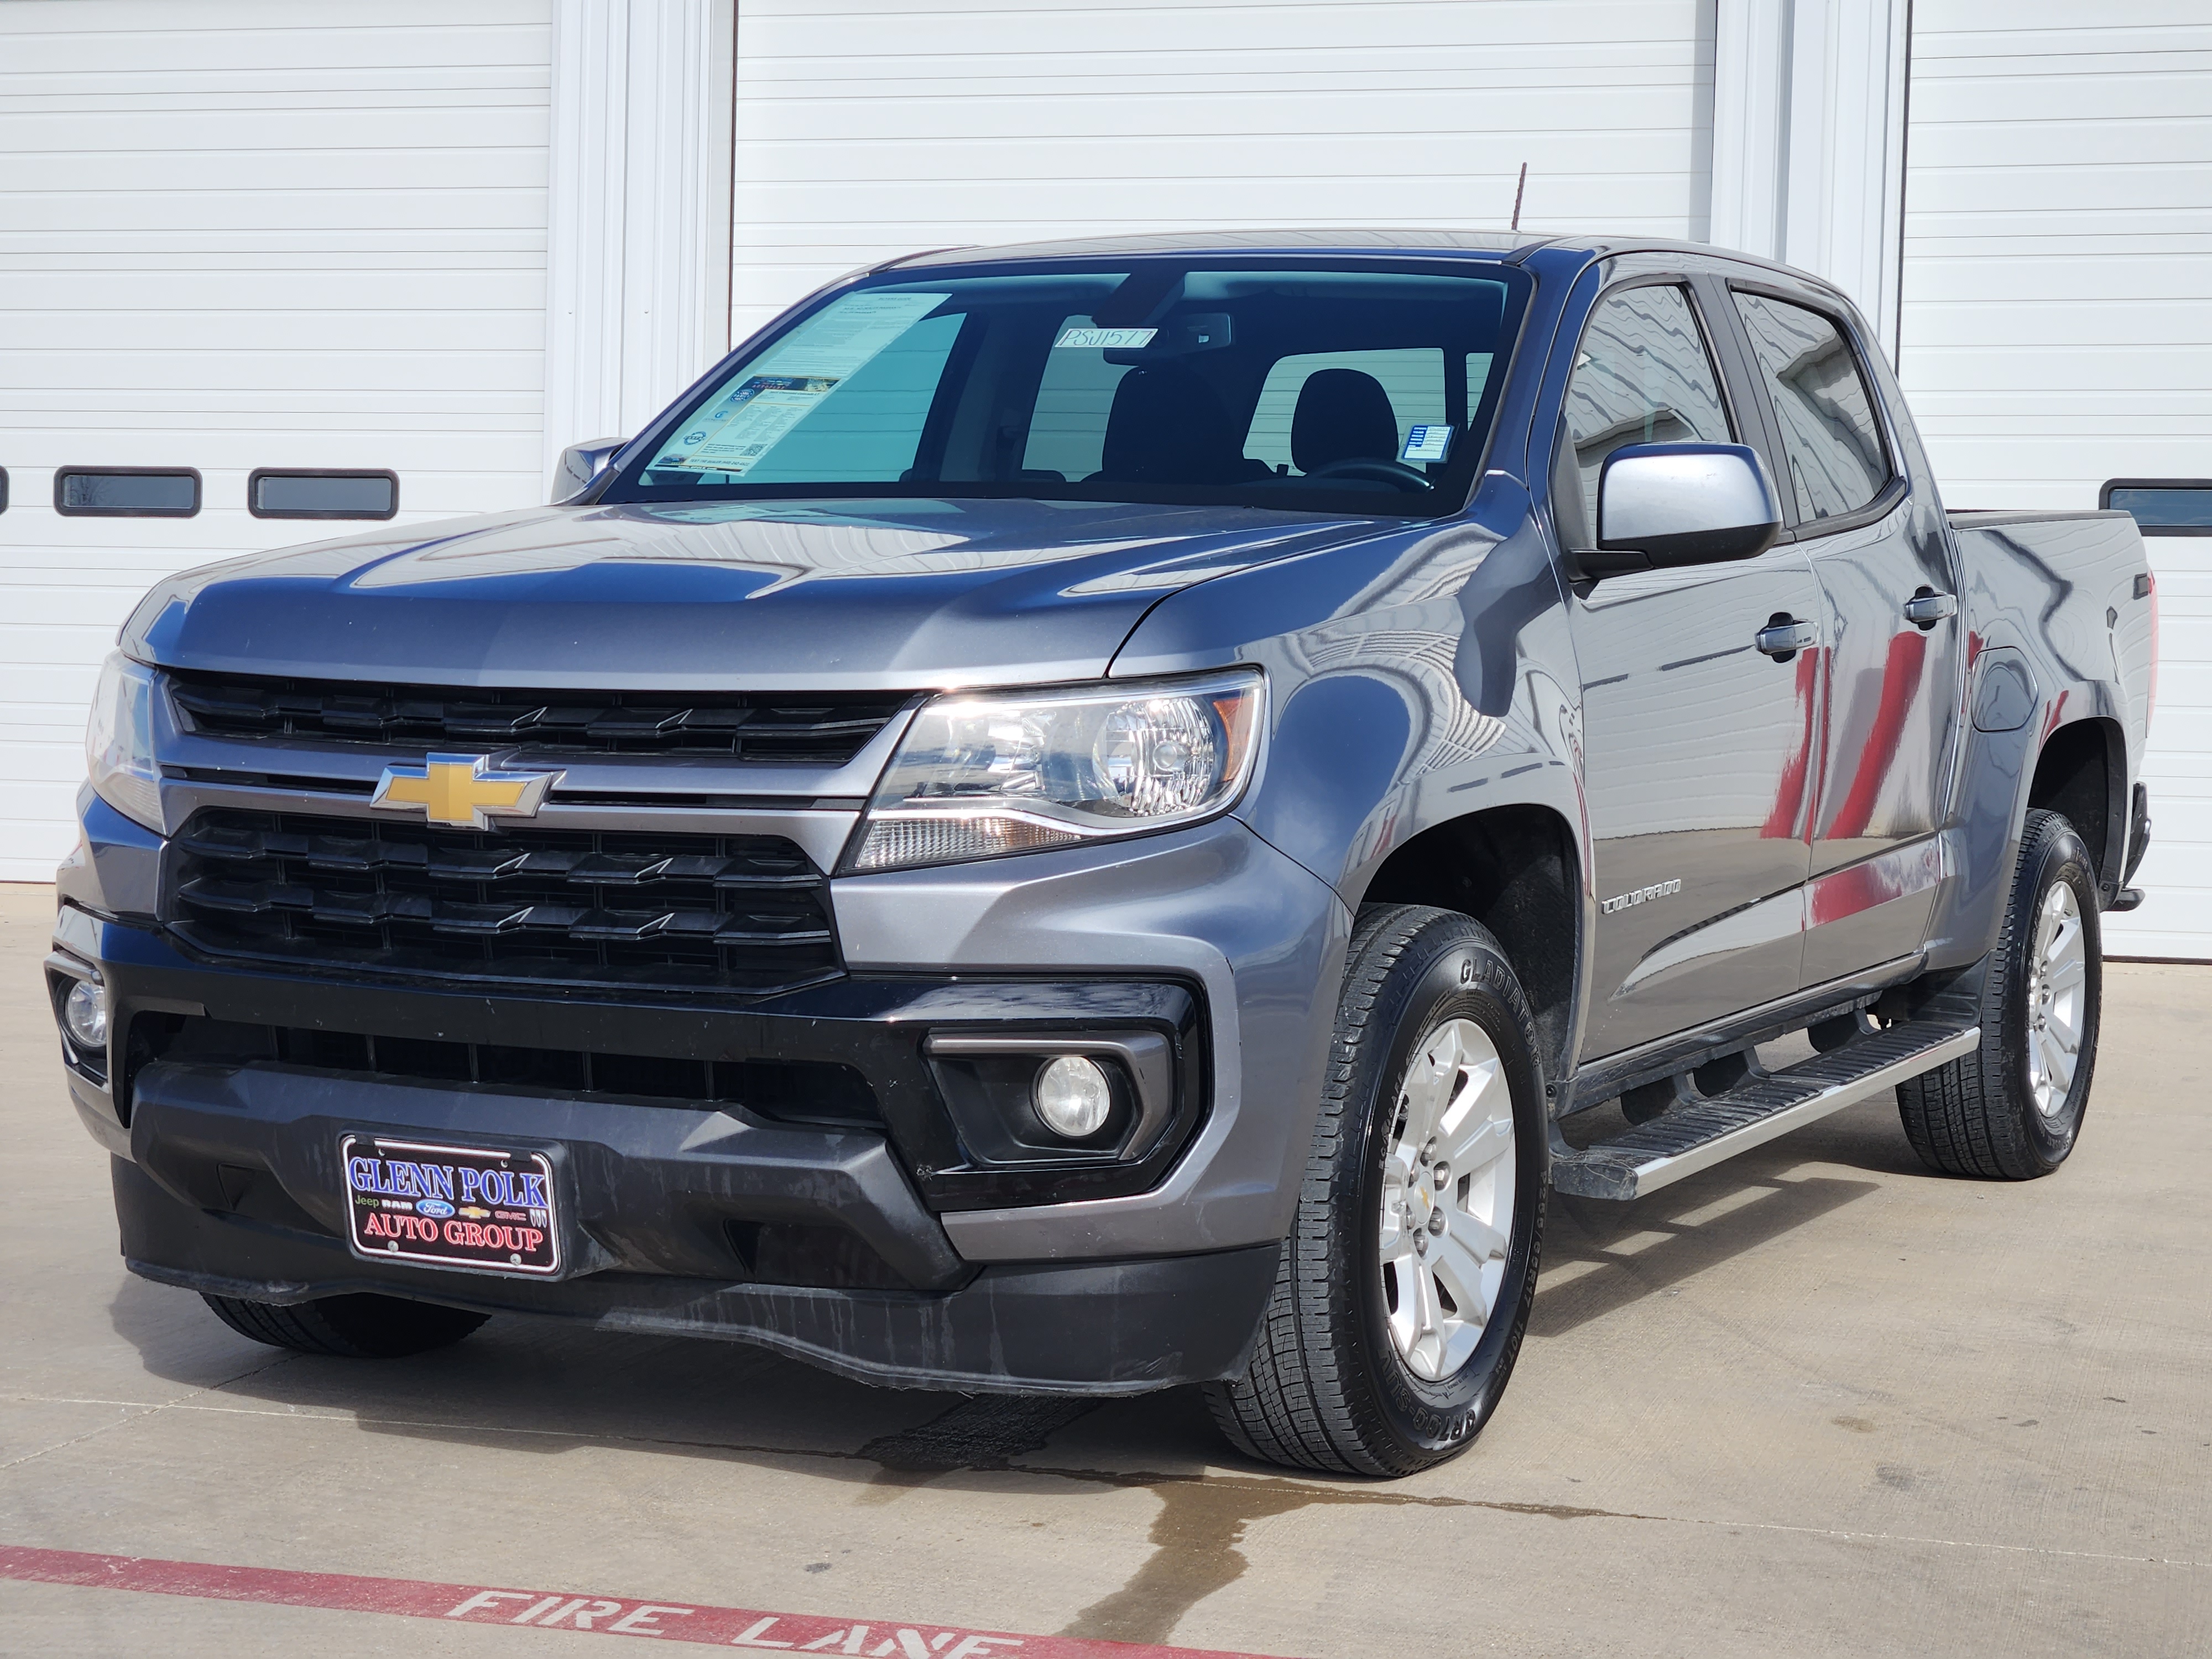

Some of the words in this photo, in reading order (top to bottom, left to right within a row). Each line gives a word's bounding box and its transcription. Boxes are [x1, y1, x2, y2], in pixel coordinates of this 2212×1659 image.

[1601, 879, 1681, 914] COLORADO
[1460, 958, 1541, 1071] GLADIATOR
[349, 1156, 454, 1200] GLENN
[458, 1167, 549, 1209] POLK
[355, 1194, 380, 1208] Jeep
[382, 1199, 413, 1211] RAM
[423, 1201, 448, 1217] Ford
[494, 1210, 526, 1221] GMC
[364, 1212, 439, 1242] AUTO
[444, 1219, 544, 1252] GROUP
[1378, 1348, 1476, 1441] QR700-SUV
[444, 1590, 696, 1635] FIRE
[731, 1616, 1024, 1659] LANE
